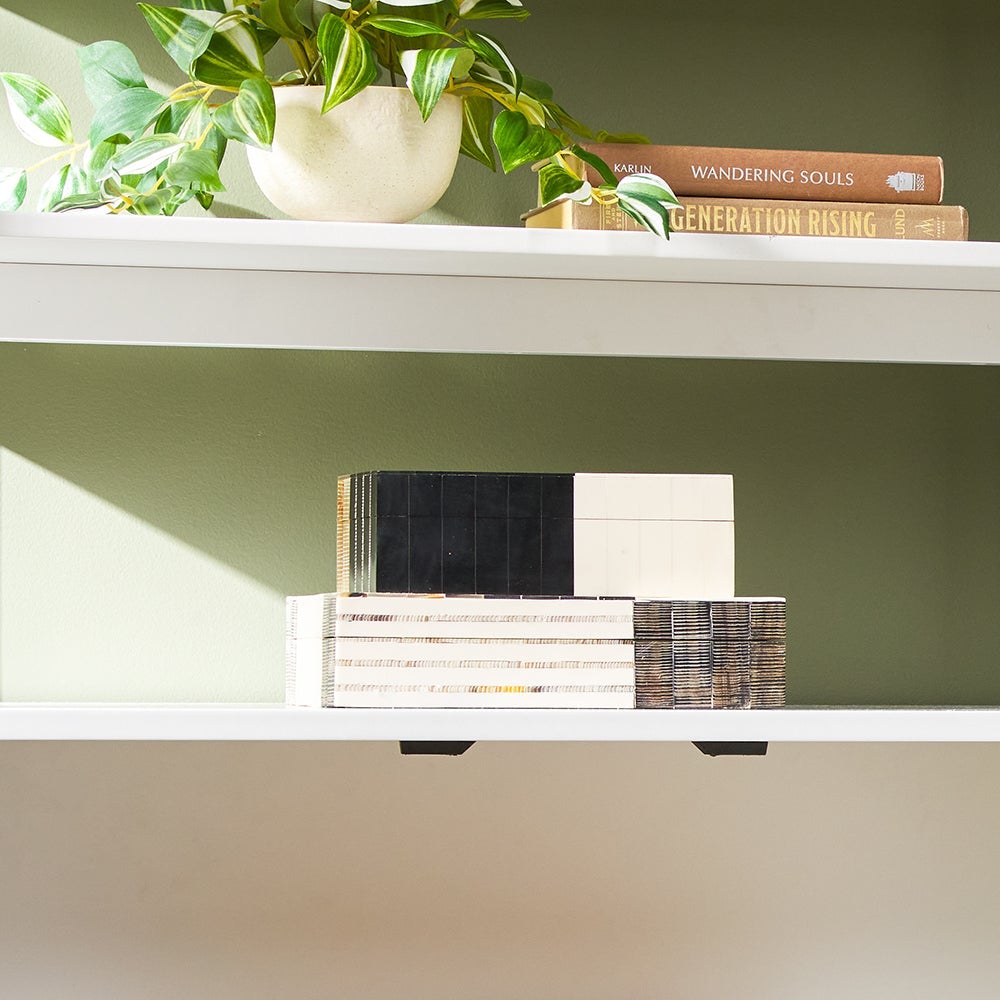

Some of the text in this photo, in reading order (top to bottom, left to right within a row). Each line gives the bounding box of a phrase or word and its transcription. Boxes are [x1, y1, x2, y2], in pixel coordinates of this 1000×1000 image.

[614, 163, 652, 174] KARLIN
[691, 165, 854, 186] WANDERING SOULS
[670, 204, 876, 237] GENERATION RISING
